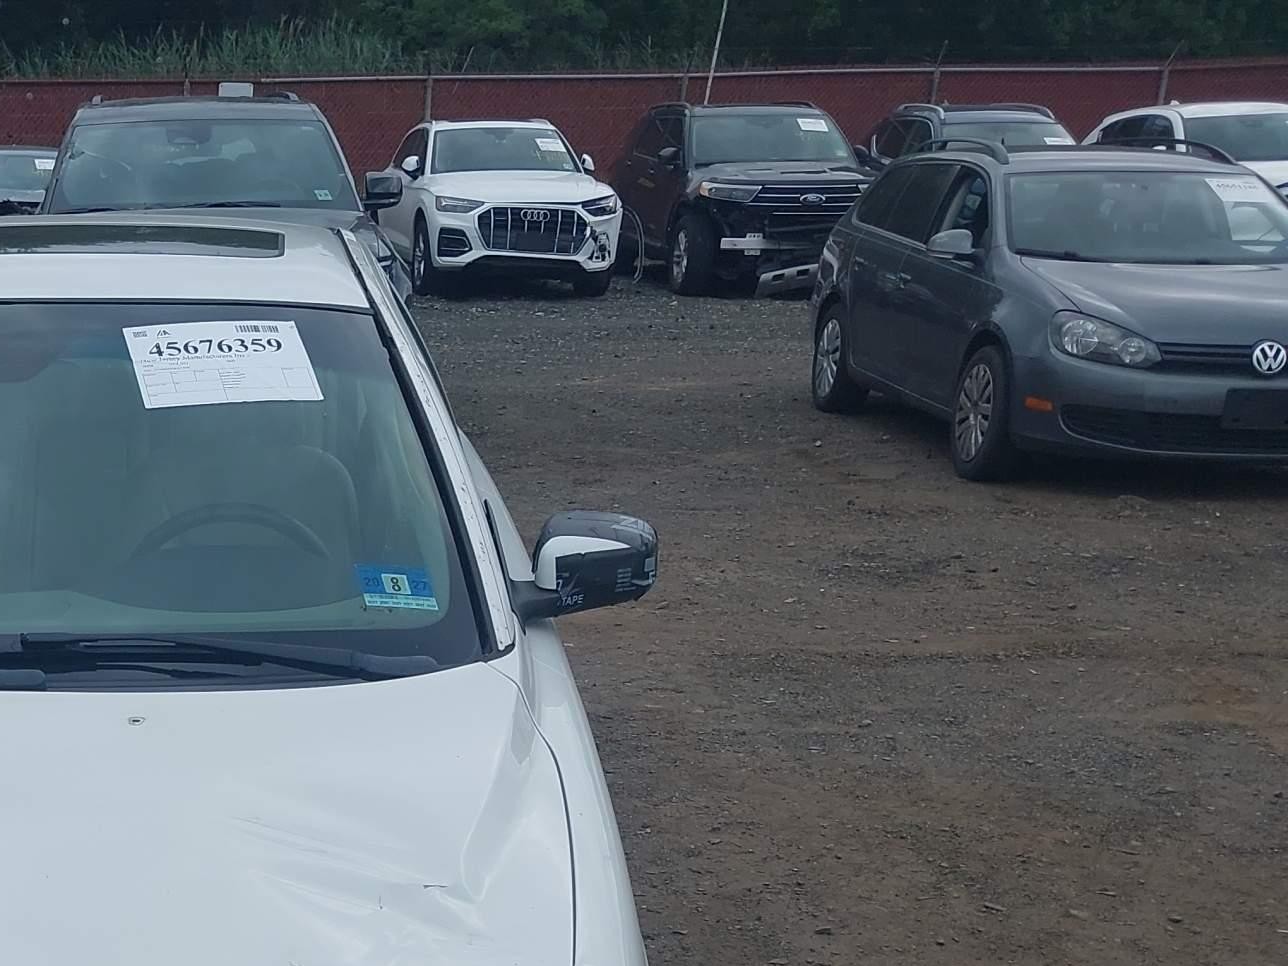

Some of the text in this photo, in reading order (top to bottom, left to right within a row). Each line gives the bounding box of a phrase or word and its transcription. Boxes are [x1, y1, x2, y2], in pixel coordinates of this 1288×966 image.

[148, 337, 283, 357] 45676359
[1253, 341, 1287, 374] VW
[390, 576, 402, 592] 8
[562, 594, 585, 606] TAPE
